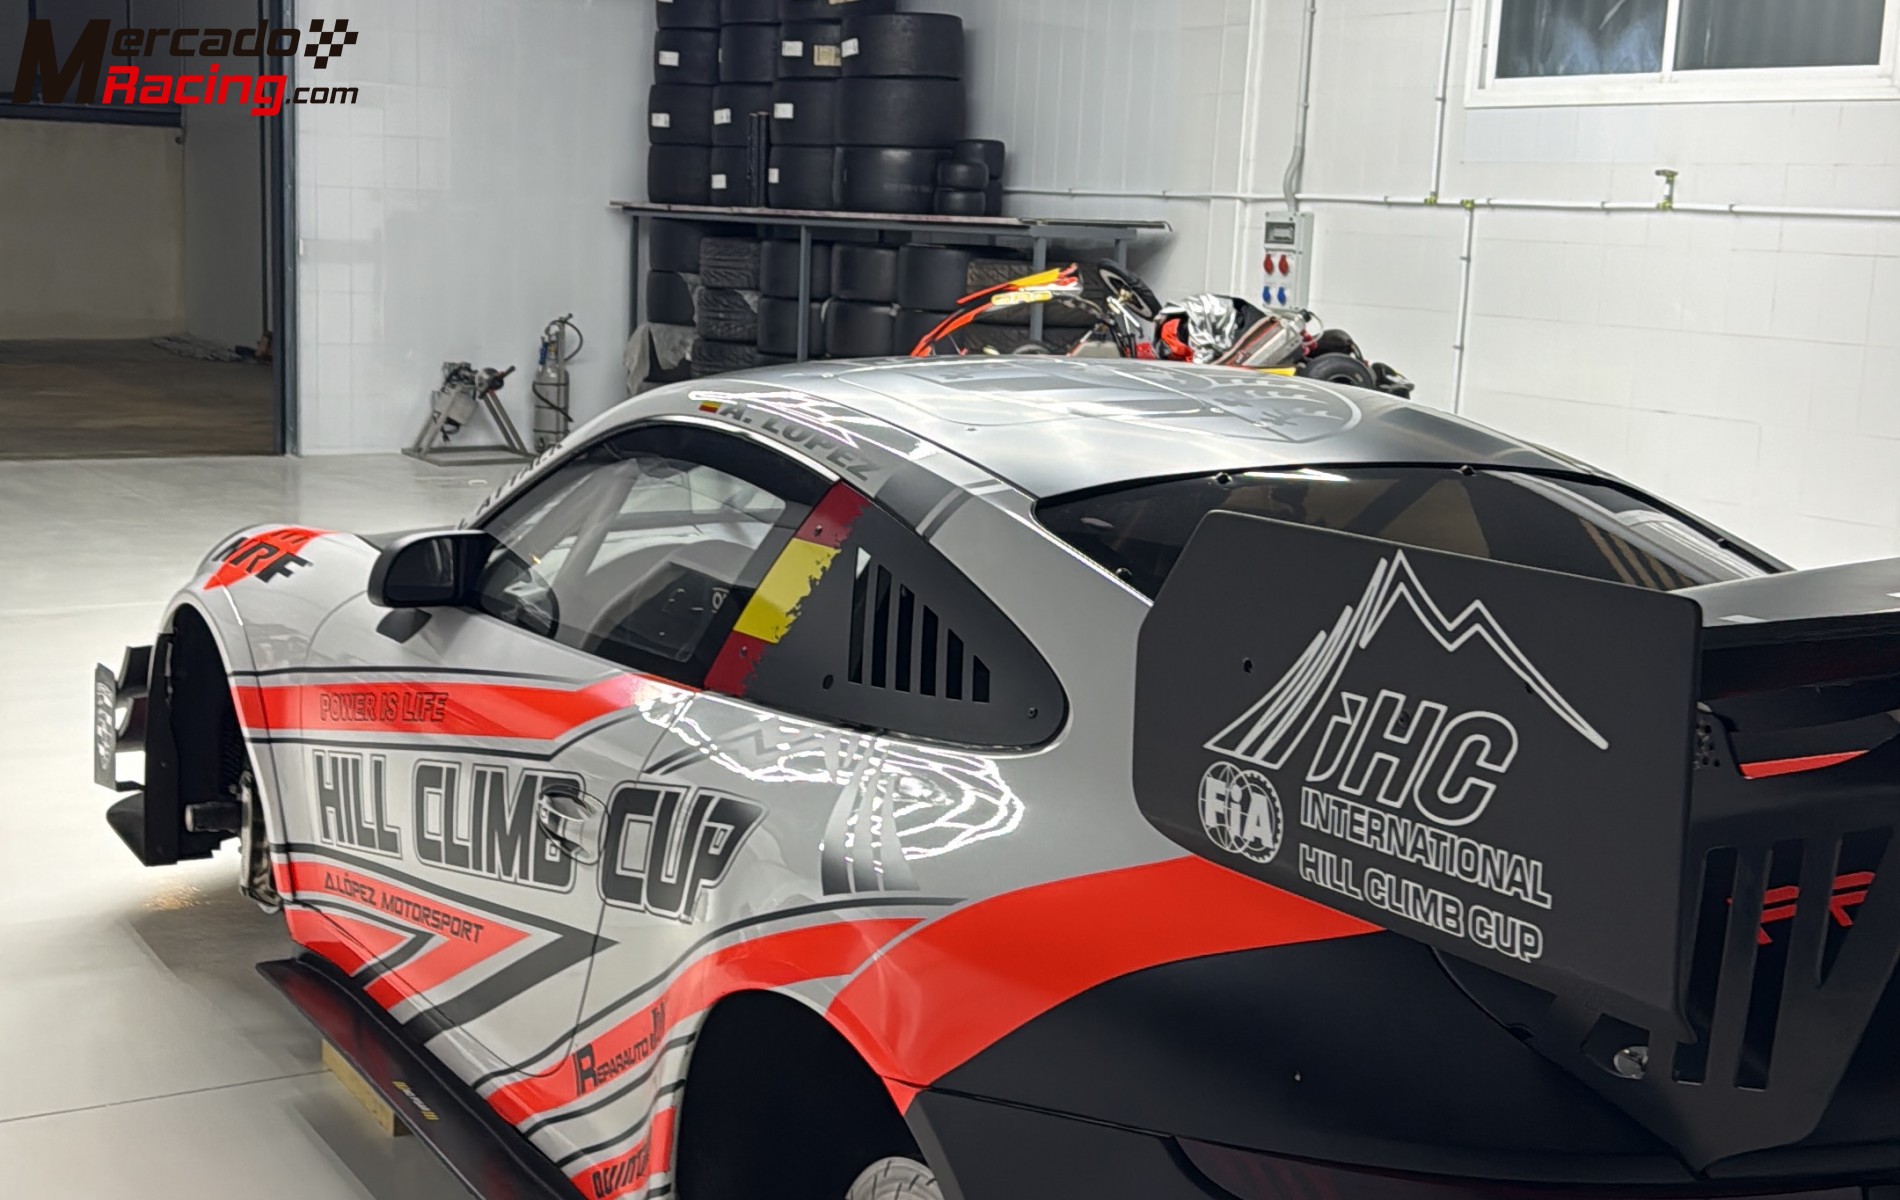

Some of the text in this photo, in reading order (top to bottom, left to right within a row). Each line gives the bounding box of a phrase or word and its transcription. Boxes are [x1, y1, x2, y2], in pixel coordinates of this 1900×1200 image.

[320, 691, 450, 722] POWER IS LIFE
[312, 748, 770, 926] HILL CLIMB CUP
[1300, 785, 1553, 911] INTERNATIONAL
[380, 891, 485, 944] MOTORSPORT
[1299, 842, 1544, 964] HILL CLIMB CUP
[572, 1042, 649, 1098] REPARAUTO
